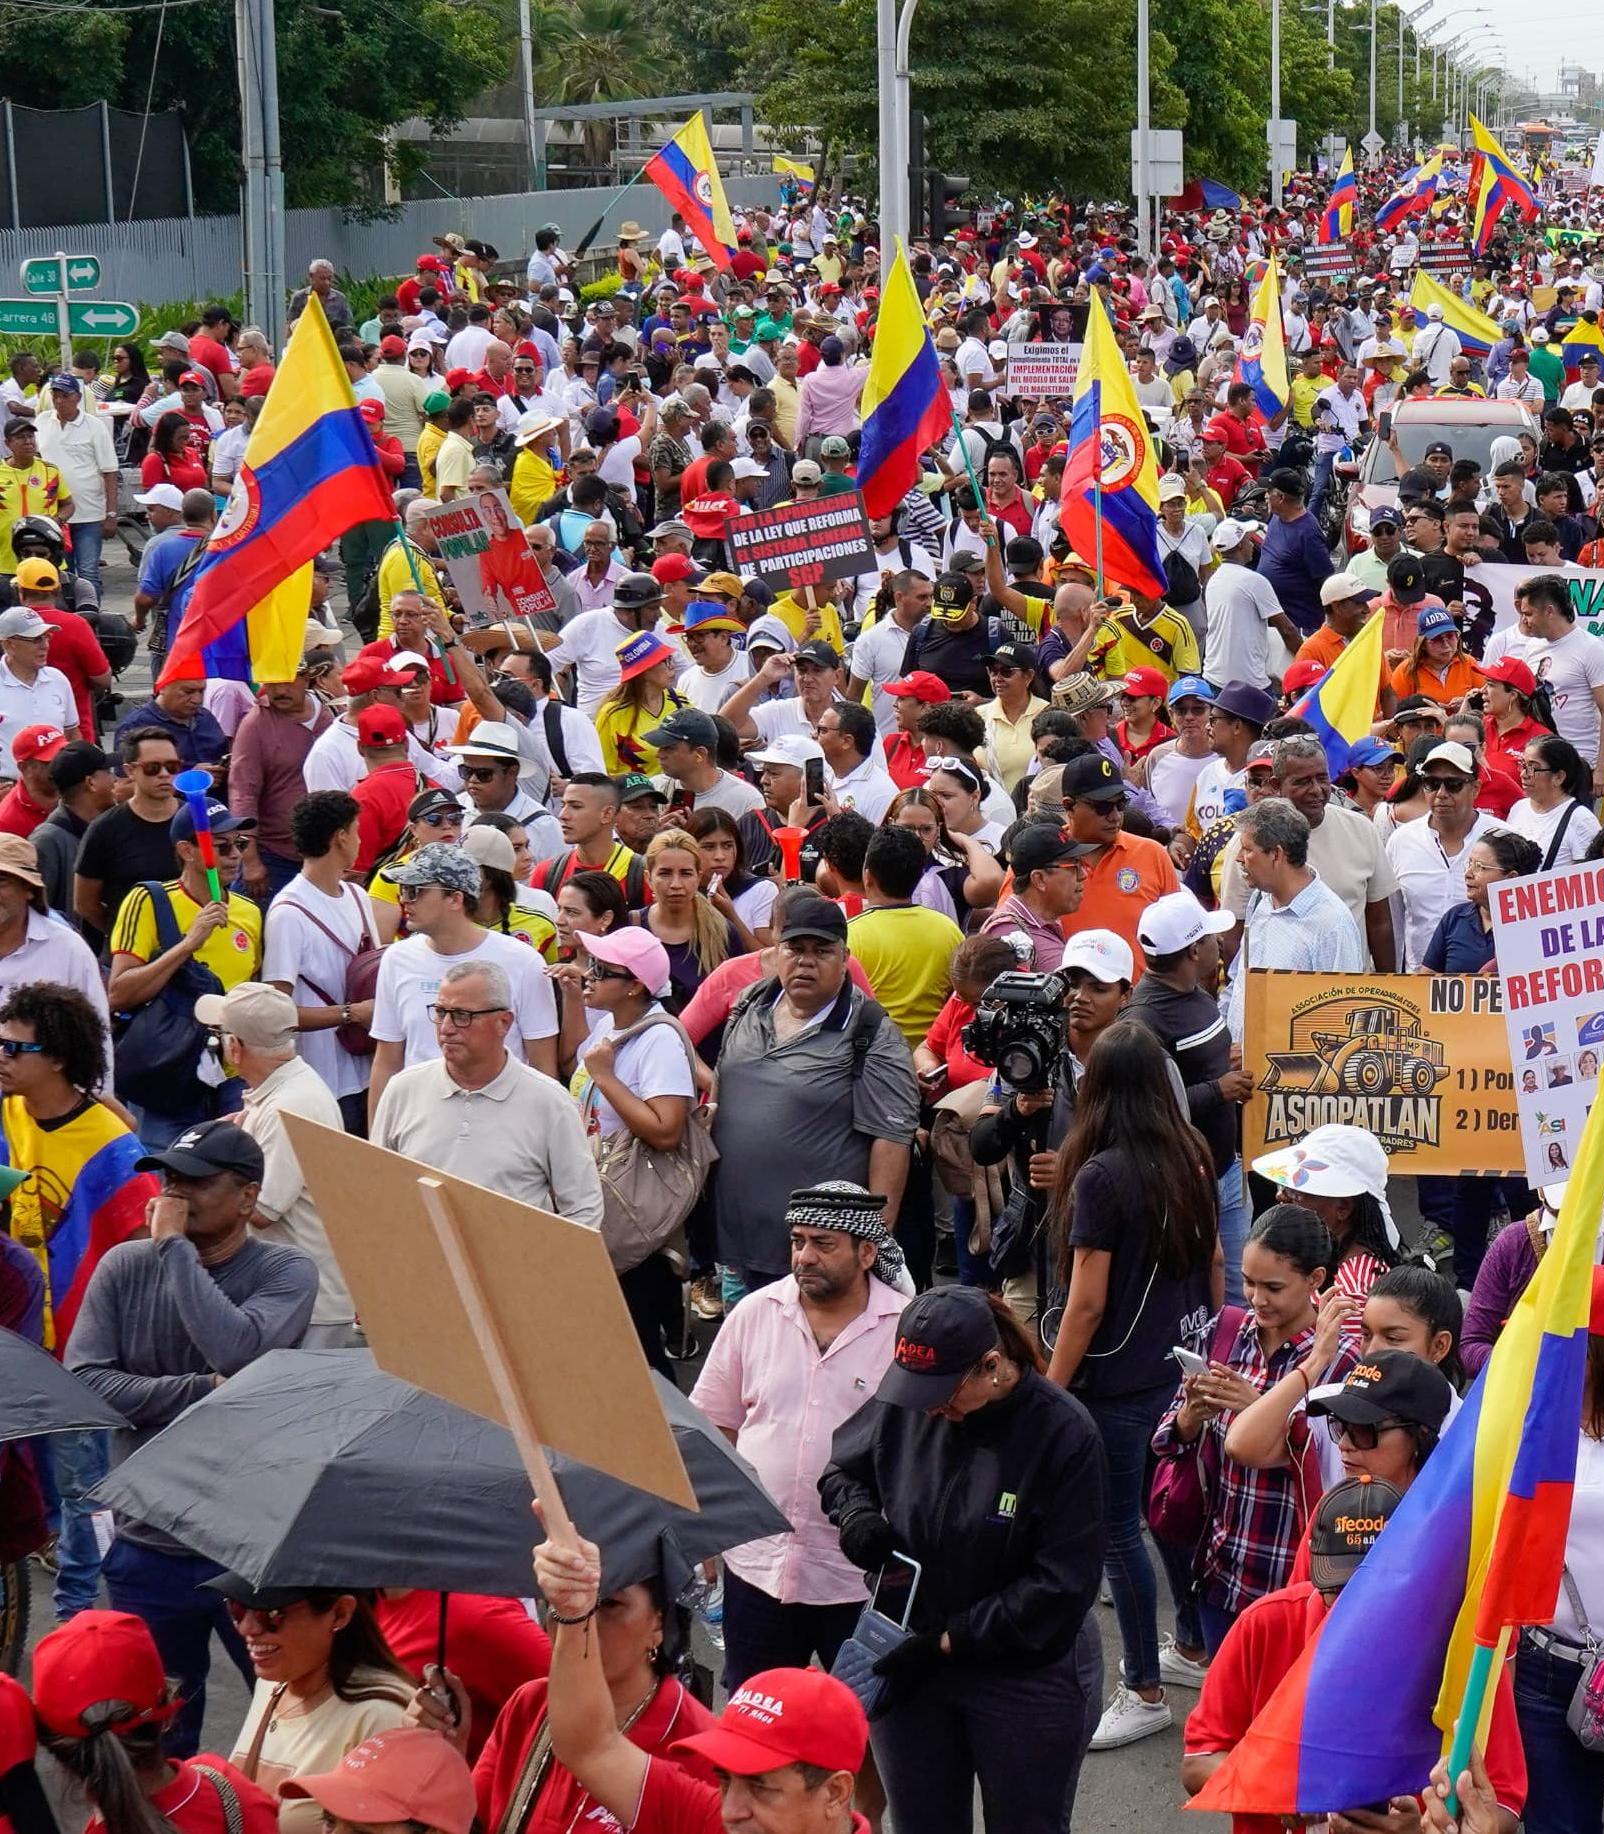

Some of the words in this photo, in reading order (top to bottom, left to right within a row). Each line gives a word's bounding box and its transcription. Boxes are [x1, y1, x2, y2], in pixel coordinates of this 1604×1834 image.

[1024, 345, 1060, 356] Exigimos
[1011, 376, 1021, 384] DEL
[1018, 385, 1029, 393] DEL
[1030, 385, 1070, 394] MAGISTERIO
[429, 507, 484, 539] CONSULTA
[731, 514, 756, 534] POR
[757, 510, 774, 529] LA
[732, 530, 749, 548] DE
[749, 526, 765, 544] LA
[764, 521, 783, 543] LEY
[784, 517, 809, 537] QUE
[808, 507, 862, 532] REFORMA
[736, 546, 752, 564] EL
[753, 536, 807, 560] SISTEMA
[810, 524, 865, 549] GENERAL
[739, 562, 757, 577] DE
[760, 538, 868, 574] PARTICIPACIONES
[787, 562, 825, 588] SGP
[516, 590, 549, 607] CONSULTA
[518, 598, 555, 615] POPULAR
[624, 640, 652, 663] COLOMBIA
[1101, 760, 1112, 777] C
[1541, 923, 1576, 958] DE
[1431, 978, 1465, 1014] NO
[1408, 1042, 1421, 1051] MP
[1537, 1116, 1568, 1136] ASI
[1346, 1533, 1361, 1545] 65
